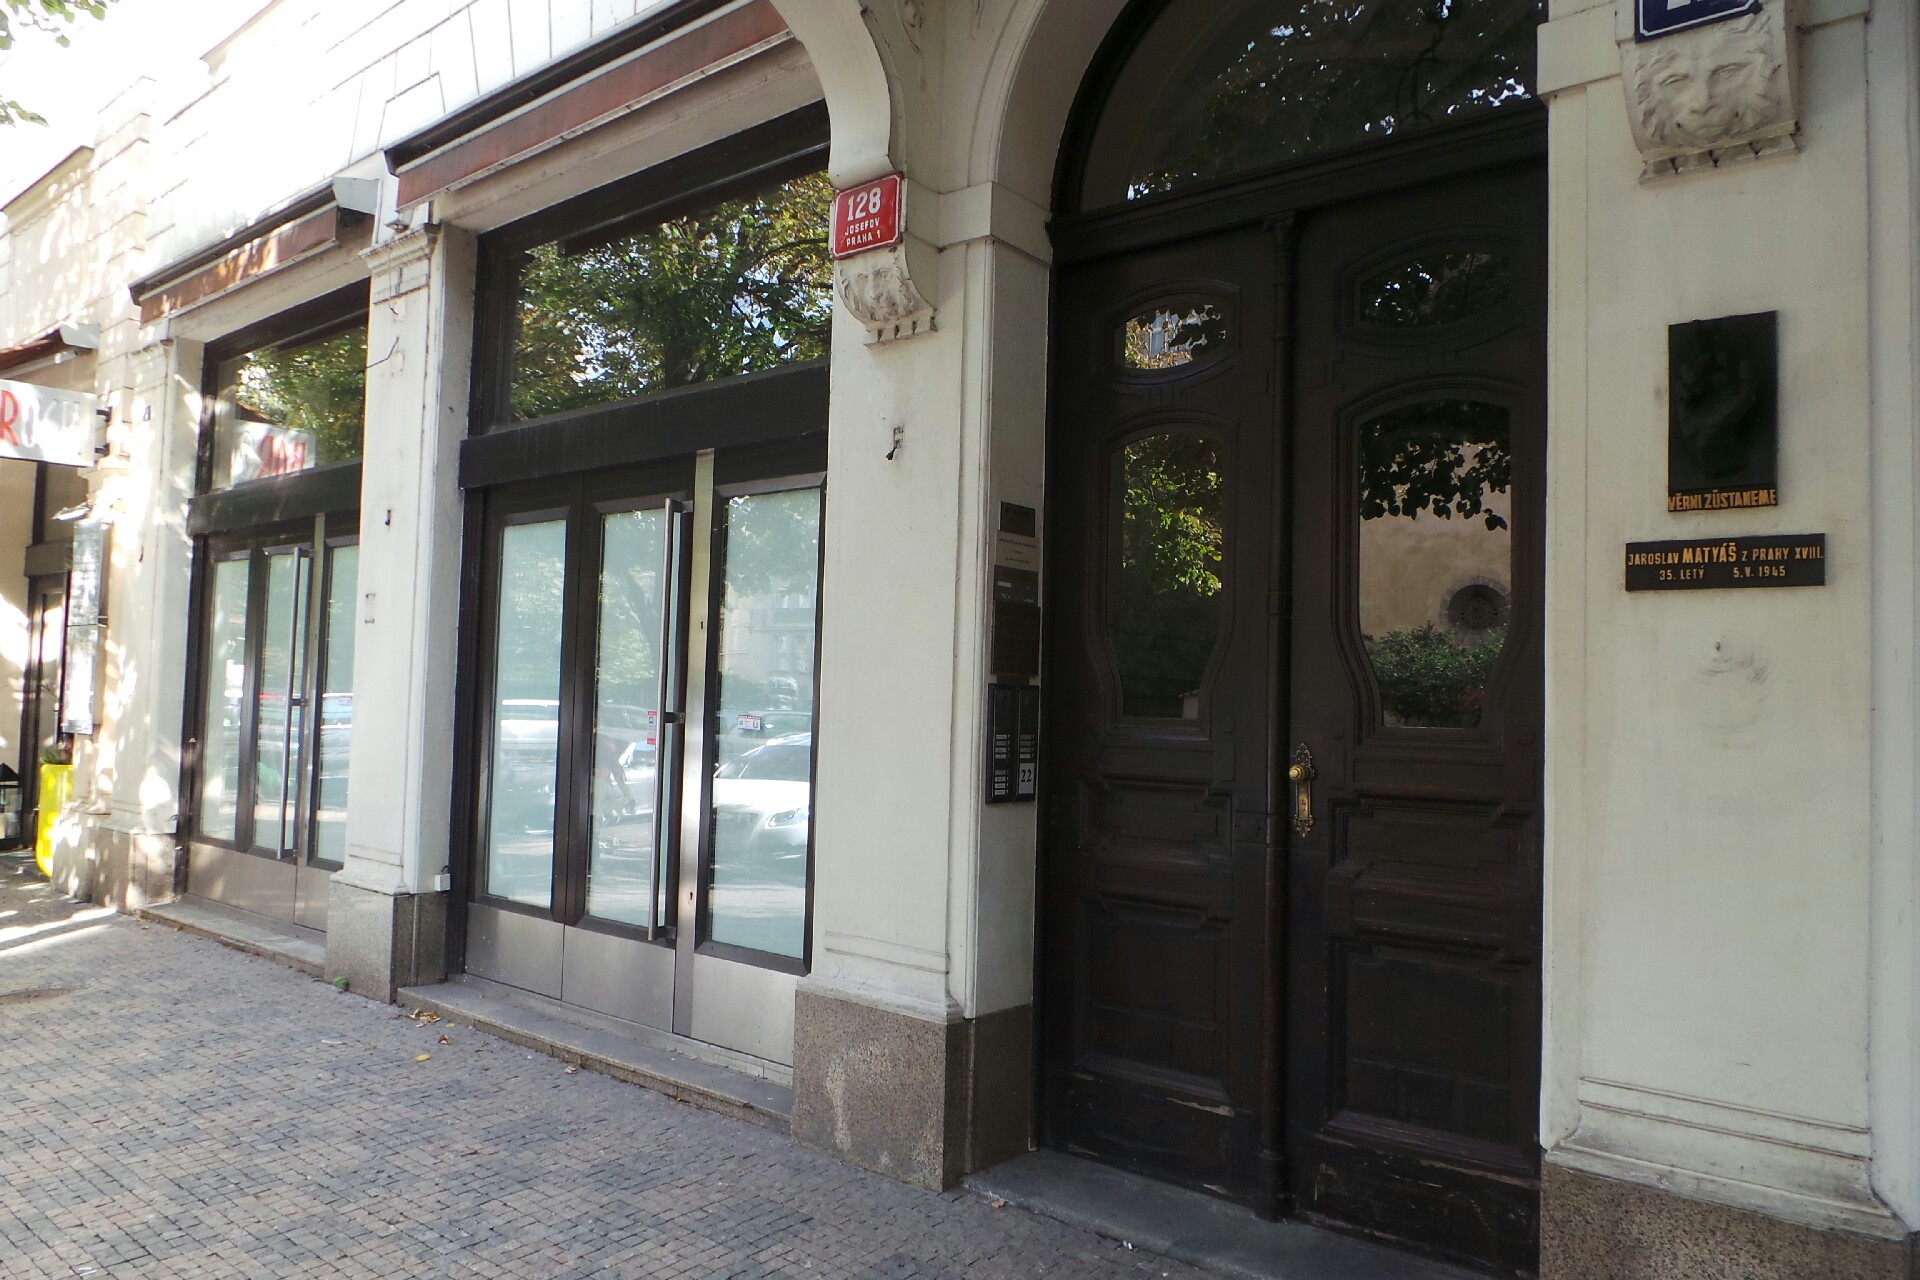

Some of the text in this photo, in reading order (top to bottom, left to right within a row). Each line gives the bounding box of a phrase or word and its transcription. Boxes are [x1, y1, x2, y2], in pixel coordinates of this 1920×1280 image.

[847, 188, 881, 221] 128
[845, 218, 880, 236] JOSEFOV
[846, 229, 881, 247] PRAHA 1
[1668, 488, 1777, 511] VĚRNI ZŮSTANEME
[1628, 552, 1680, 566] JAROSLAV
[1682, 542, 1738, 564] MATYÁŠ
[1752, 547, 1790, 561] PRAHY
[1659, 569, 1677, 581] 35.
[1680, 565, 1705, 580] LETÝ
[1758, 564, 1786, 577] 1945
[1020, 768, 1032, 783] 22
